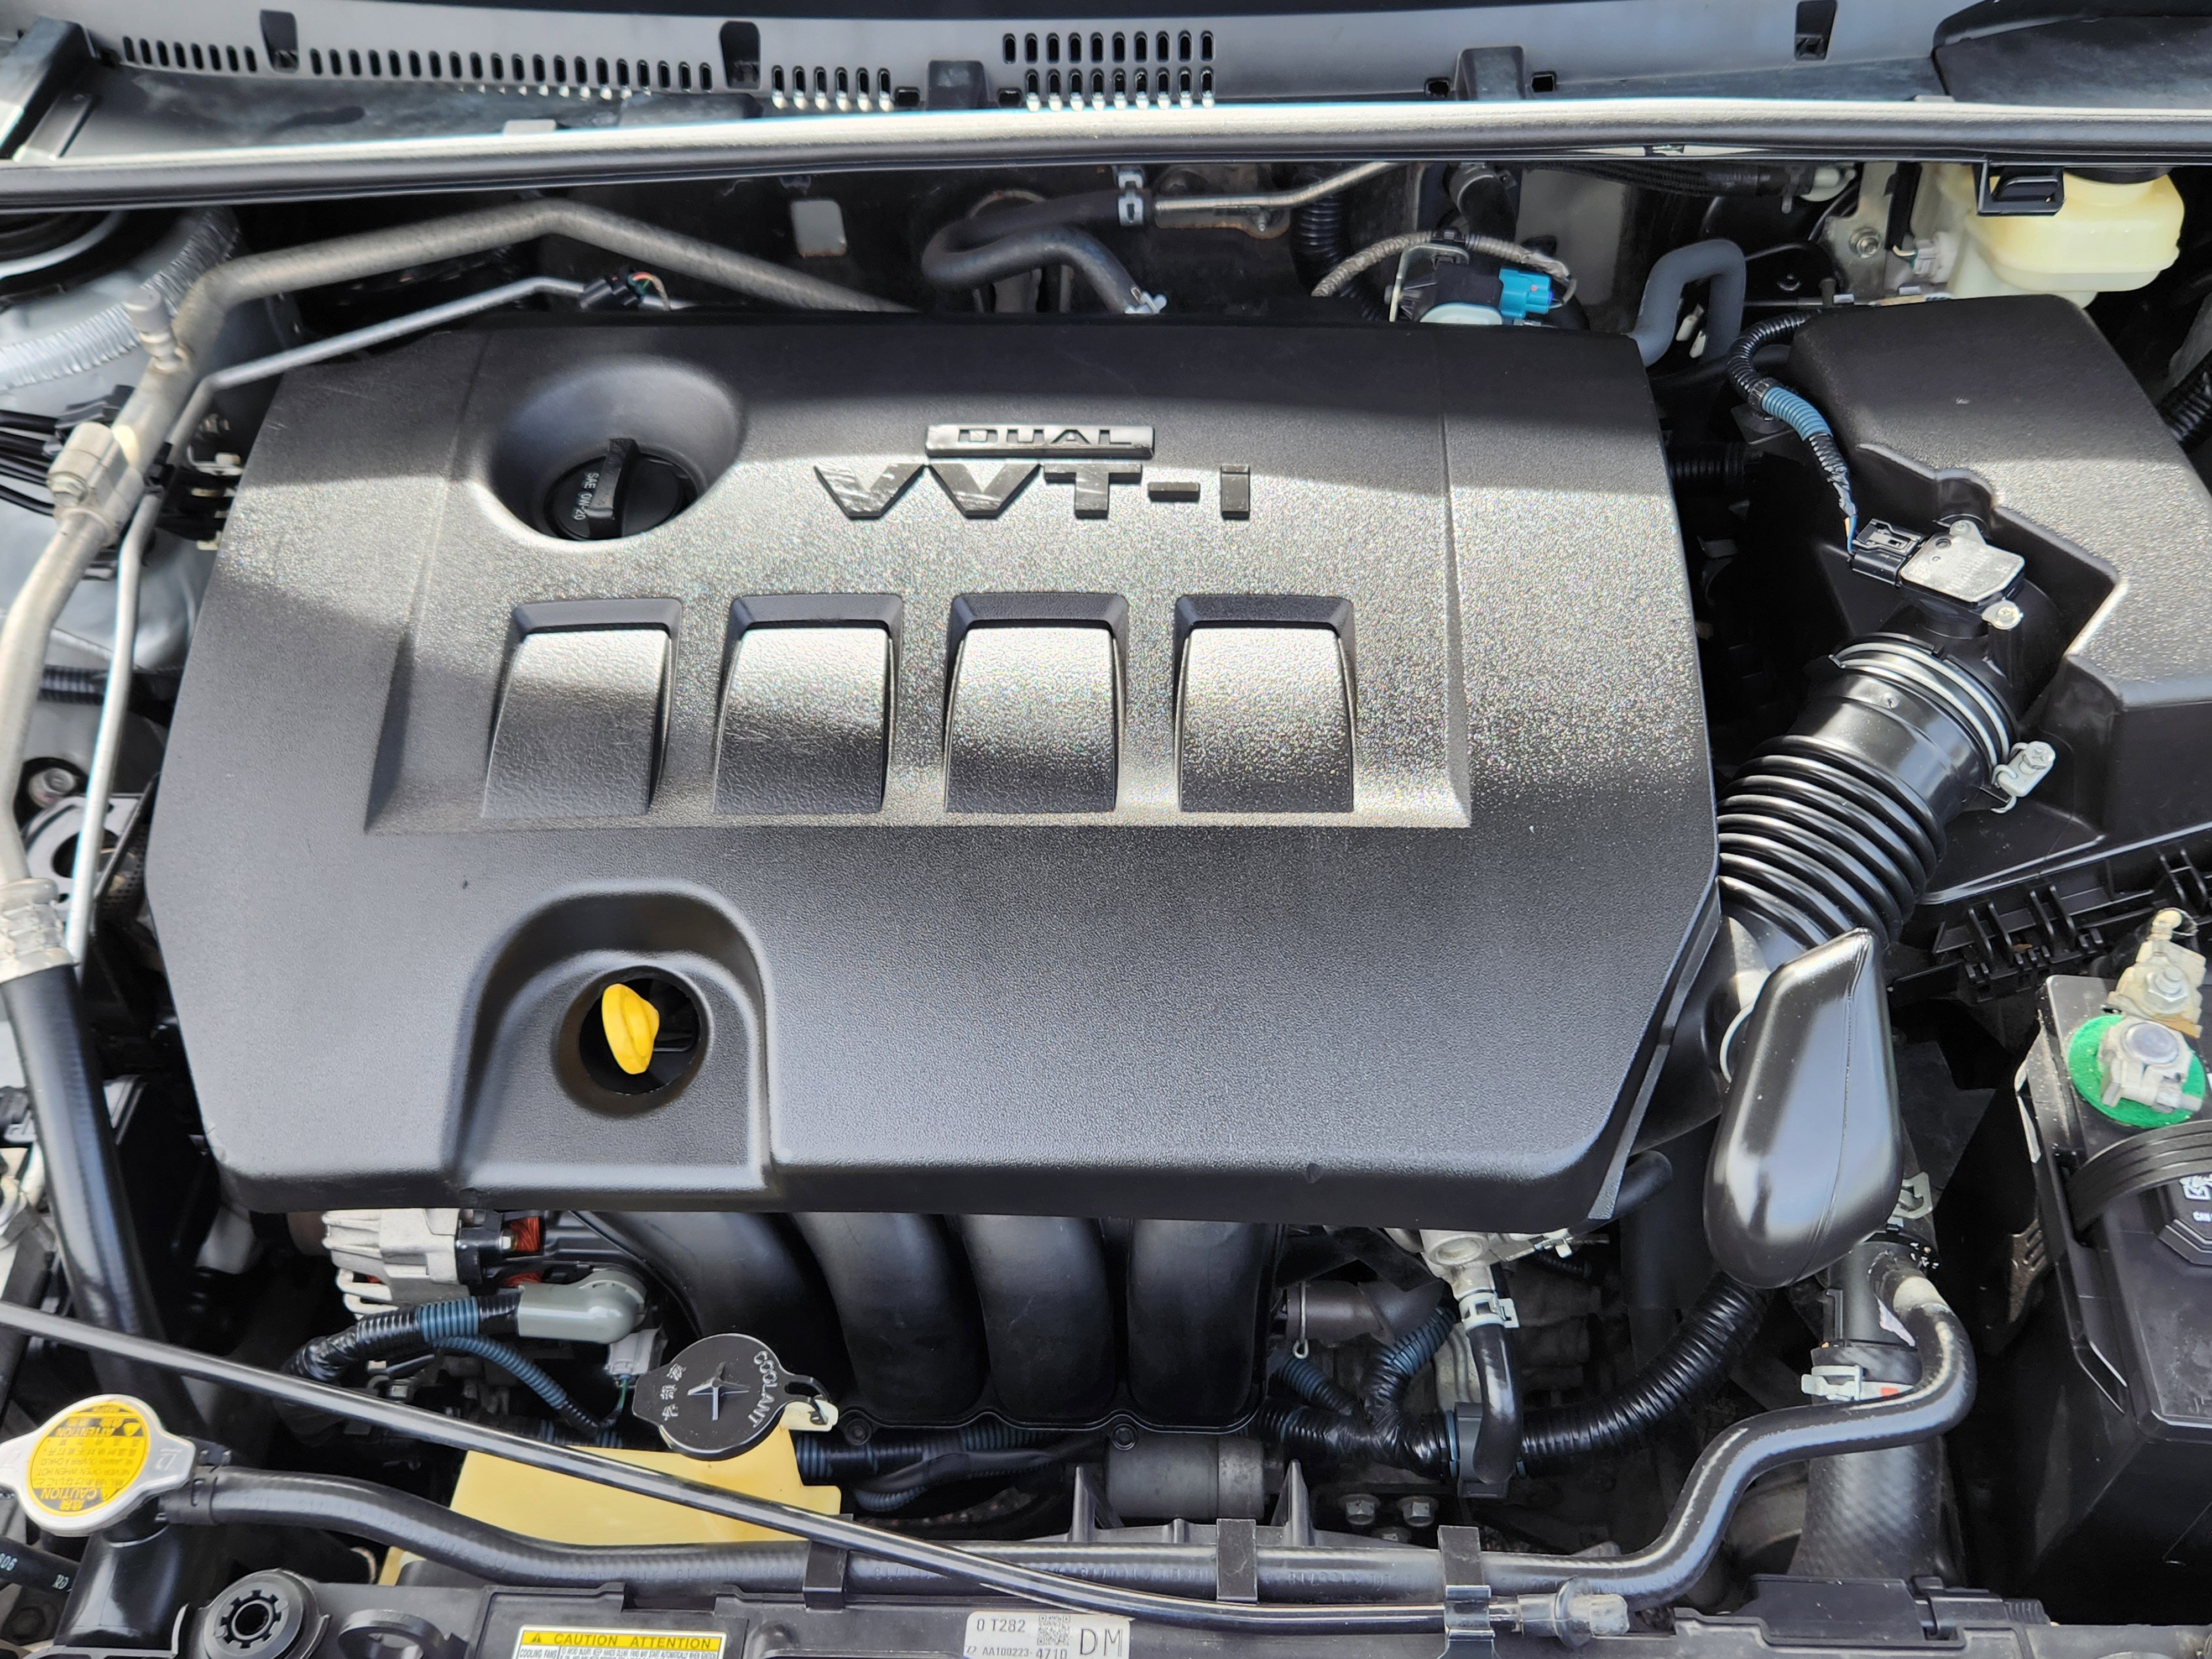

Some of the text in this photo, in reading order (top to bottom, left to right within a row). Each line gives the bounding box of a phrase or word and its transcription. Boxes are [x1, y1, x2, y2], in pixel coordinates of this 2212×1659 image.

[958, 427, 1132, 446] DUAL
[583, 472, 599, 489] SAE
[748, 1350, 778, 1428] COOLANT
[55, 1426, 116, 1437] ATTENTION
[54, 1468, 79, 1477] WHEN
[81, 1468, 102, 1477] OPEN
[104, 1468, 131, 1476] NEVER
[40, 1488, 97, 1499] CAUTION
[991, 1619, 1026, 1633] T282
[554, 1632, 711, 1650] CAUTION ATTENTION
[1079, 1628, 1123, 1657] DM
[520, 1648, 557, 1659] COOLING FANS
